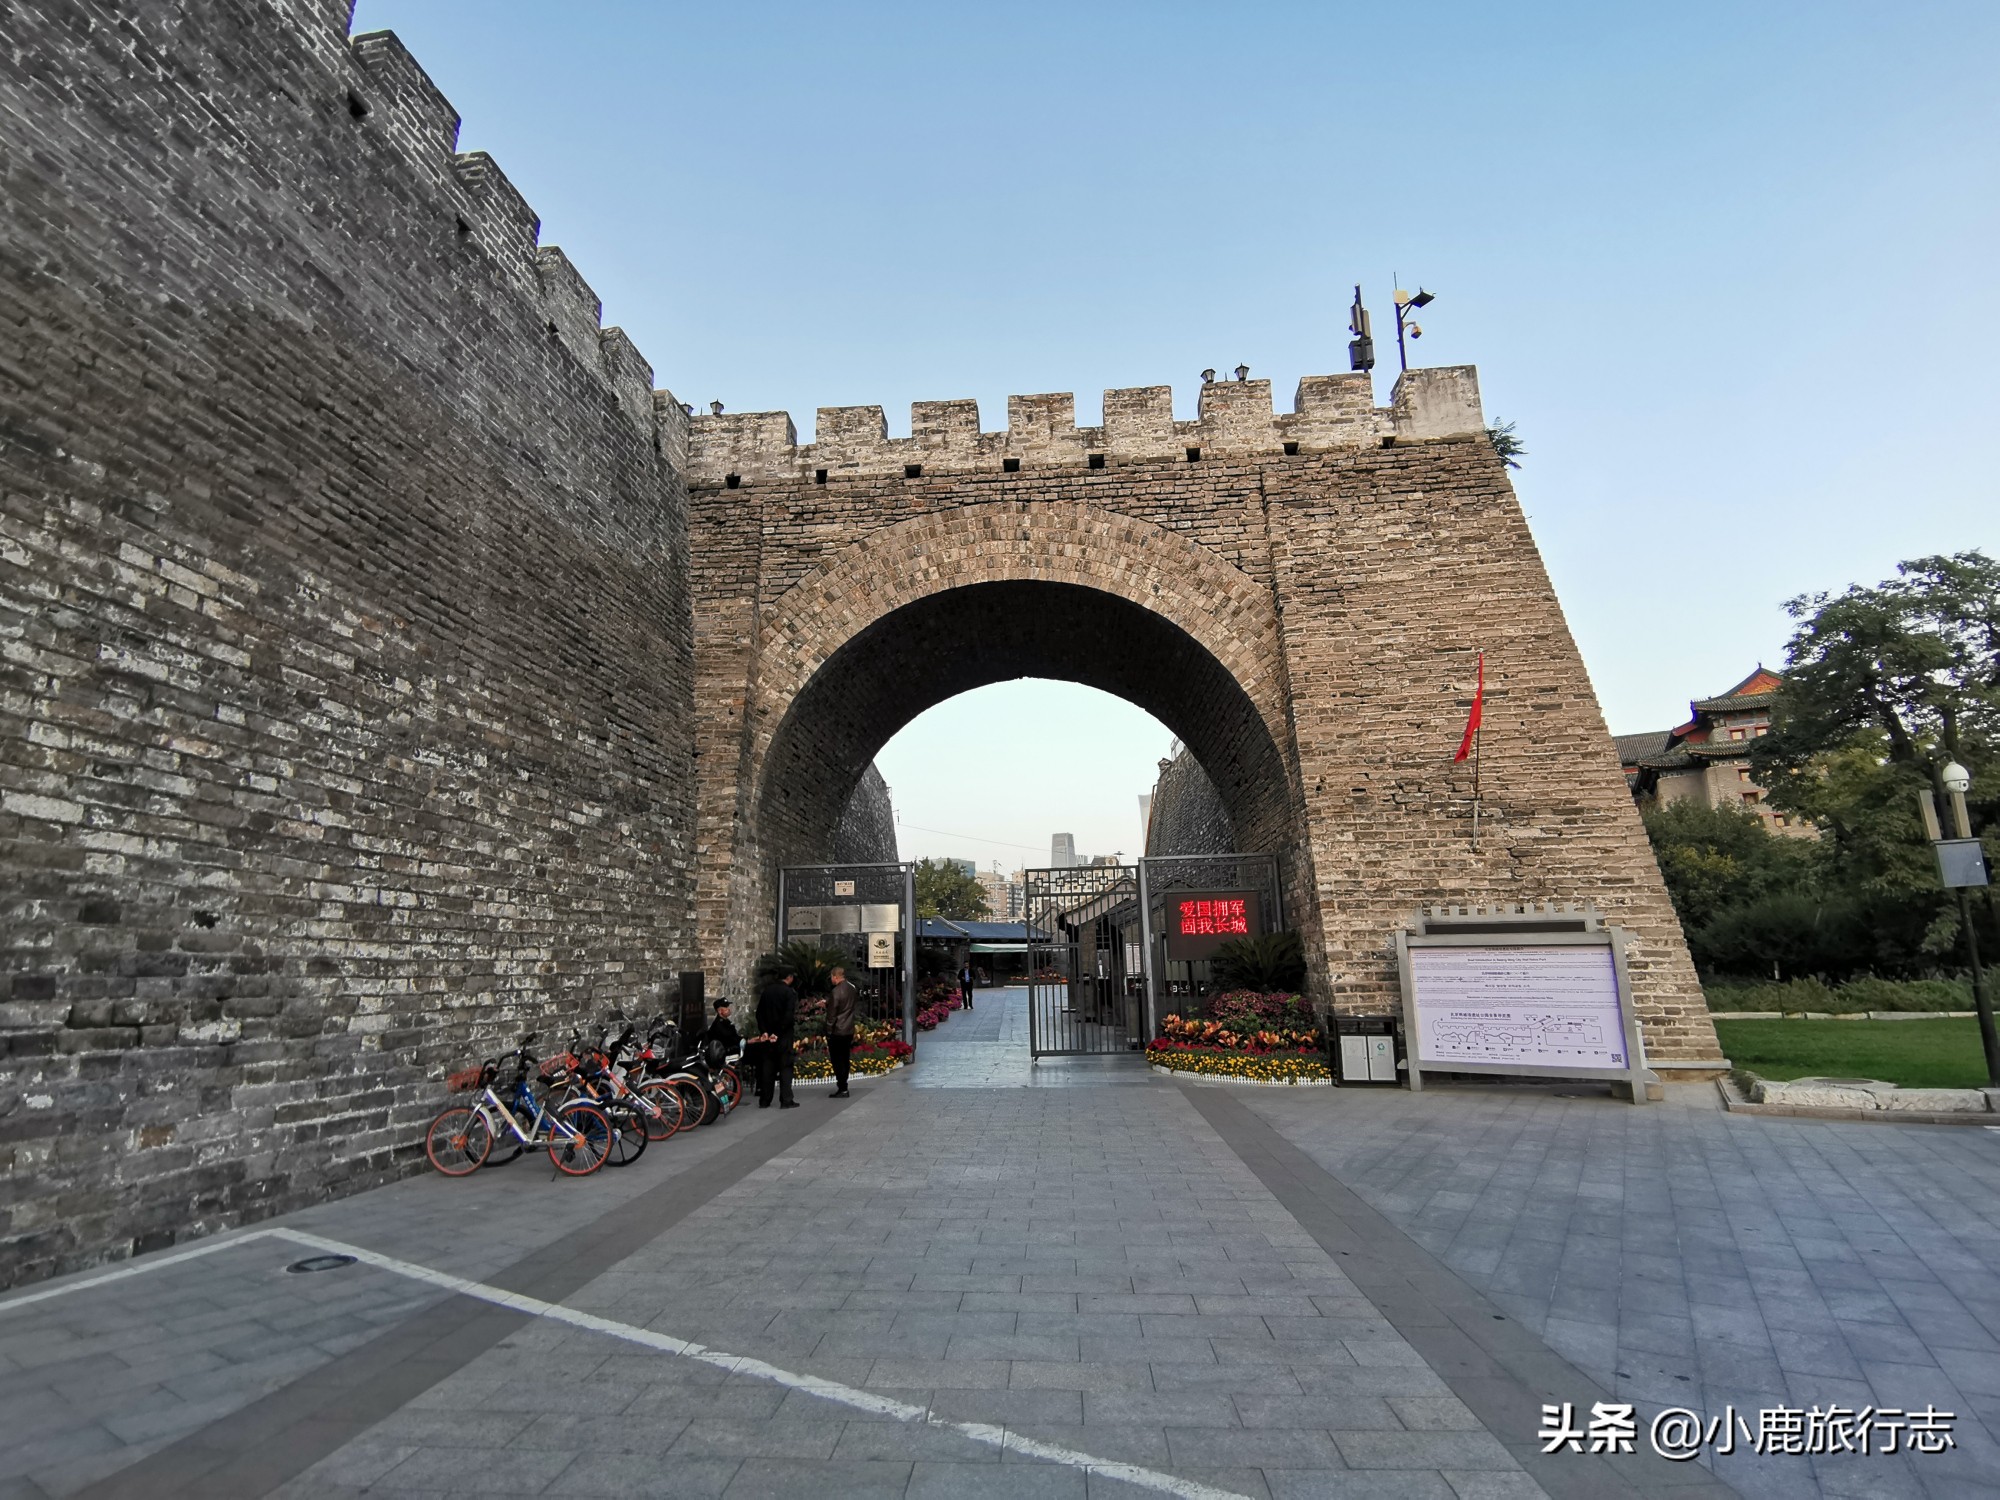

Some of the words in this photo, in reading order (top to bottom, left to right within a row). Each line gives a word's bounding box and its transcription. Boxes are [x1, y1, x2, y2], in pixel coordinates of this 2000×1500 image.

[1179, 899, 1246, 917] 爱国拥军
[1181, 917, 1248, 935] 固我长城
